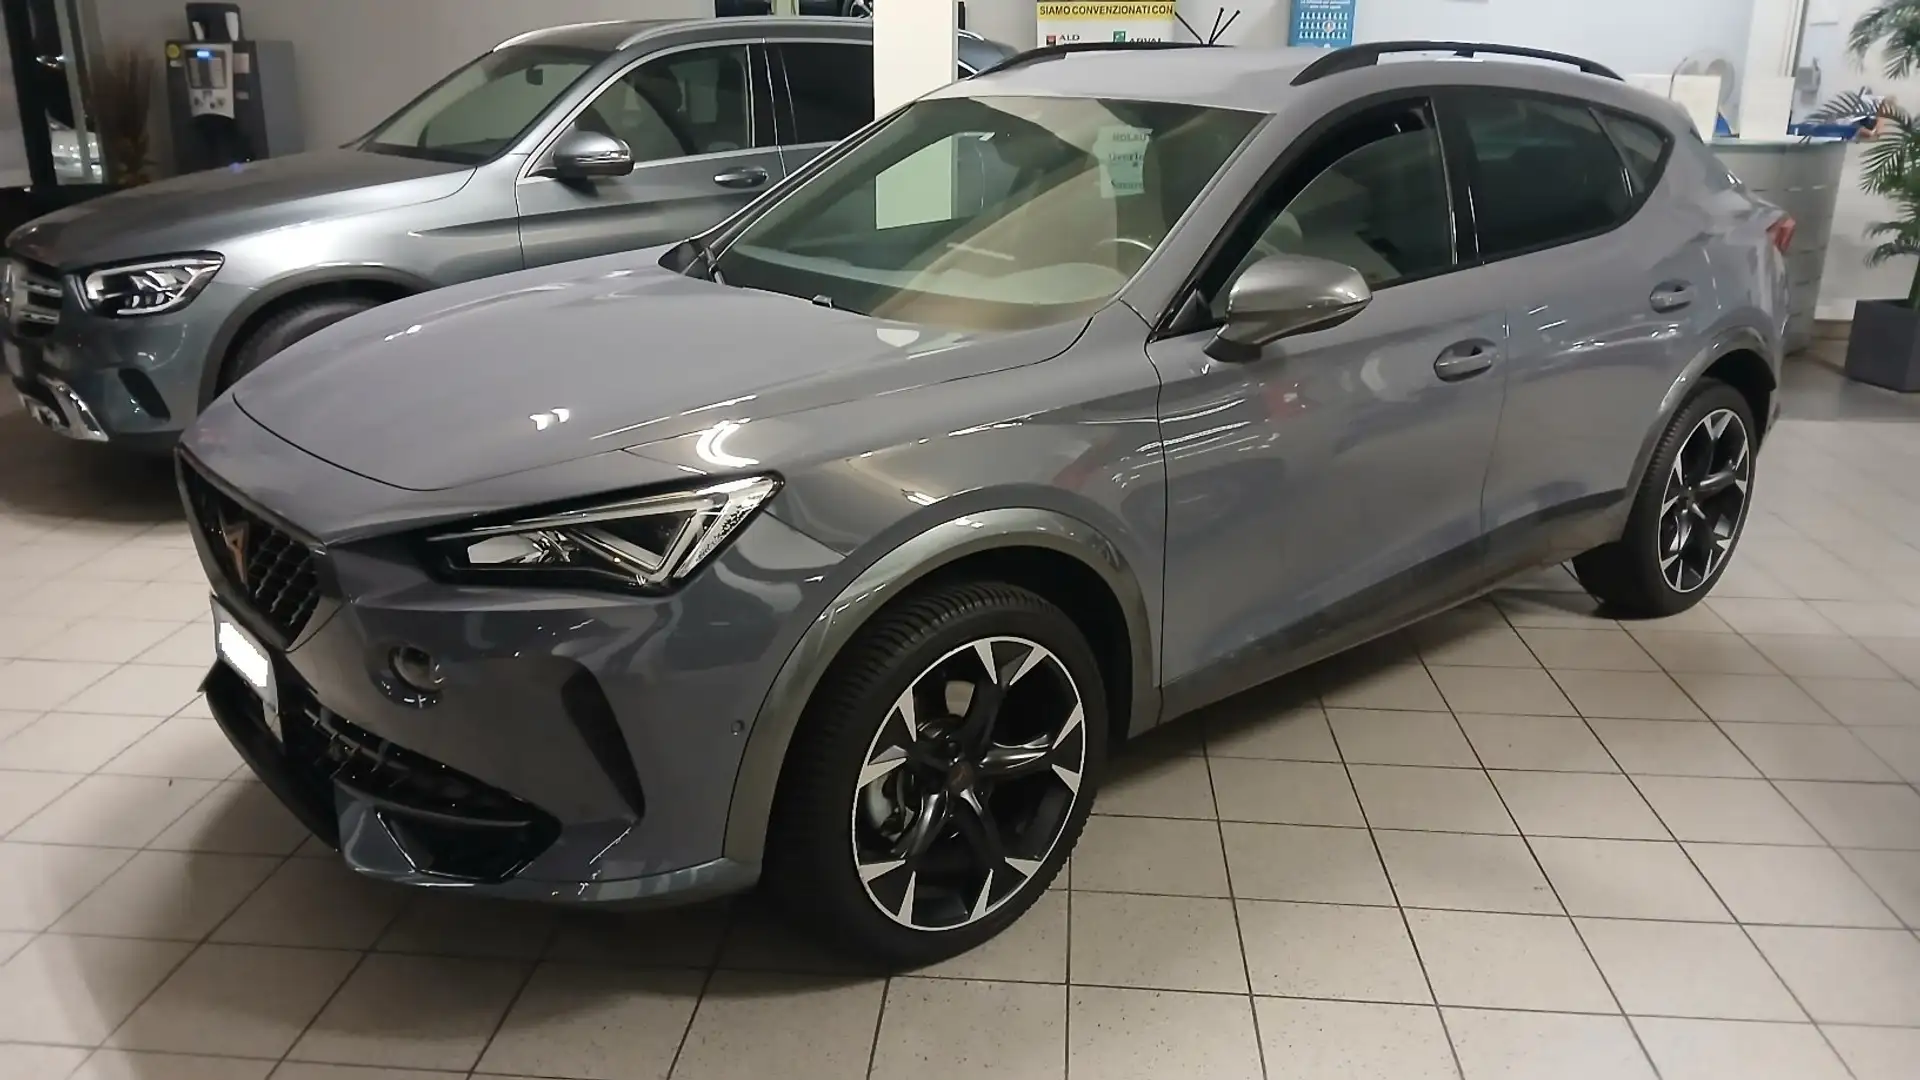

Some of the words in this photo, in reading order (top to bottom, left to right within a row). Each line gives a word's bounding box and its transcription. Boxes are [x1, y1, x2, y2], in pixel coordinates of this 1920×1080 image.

[1040, 5, 1070, 15] SIAMO
[1072, 5, 1150, 15] CONVENZIONATI
[1152, 5, 1173, 15] CON
